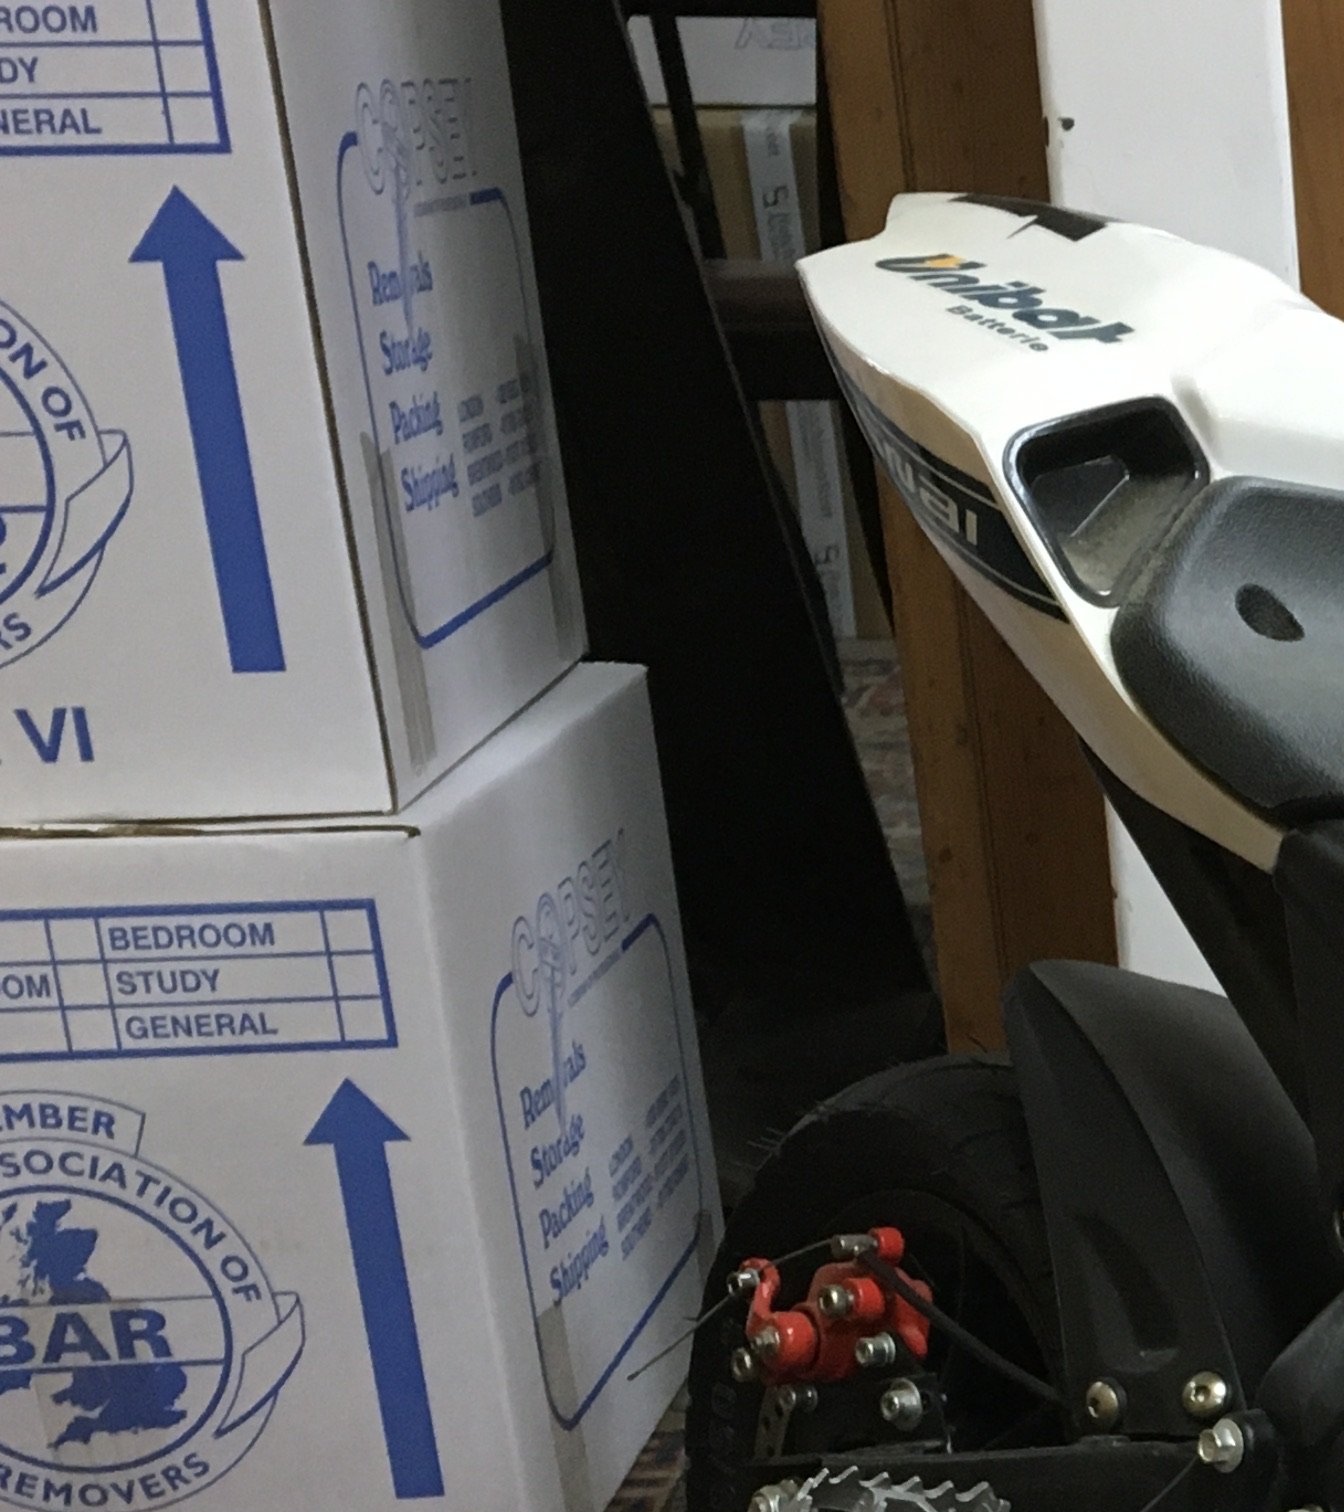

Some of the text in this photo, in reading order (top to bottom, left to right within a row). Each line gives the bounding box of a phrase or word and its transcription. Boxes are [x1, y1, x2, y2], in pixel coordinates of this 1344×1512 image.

[356, 76, 478, 195] COPSE
[367, 251, 434, 306] Remals
[946, 304, 1049, 354] Batterie
[14, 706, 96, 763] VI
[108, 921, 275, 951] BEDROOM
[512, 828, 630, 1018] COPSE
[116, 968, 220, 995] STUDY
[125, 1012, 278, 1040] GENERAL
[520, 1038, 586, 1130] Remals
[0, 1103, 116, 1139] MBER
[538, 1165, 594, 1250] Packing
[219, 1254, 262, 1303] OF
[550, 1214, 610, 1307] Shipping
